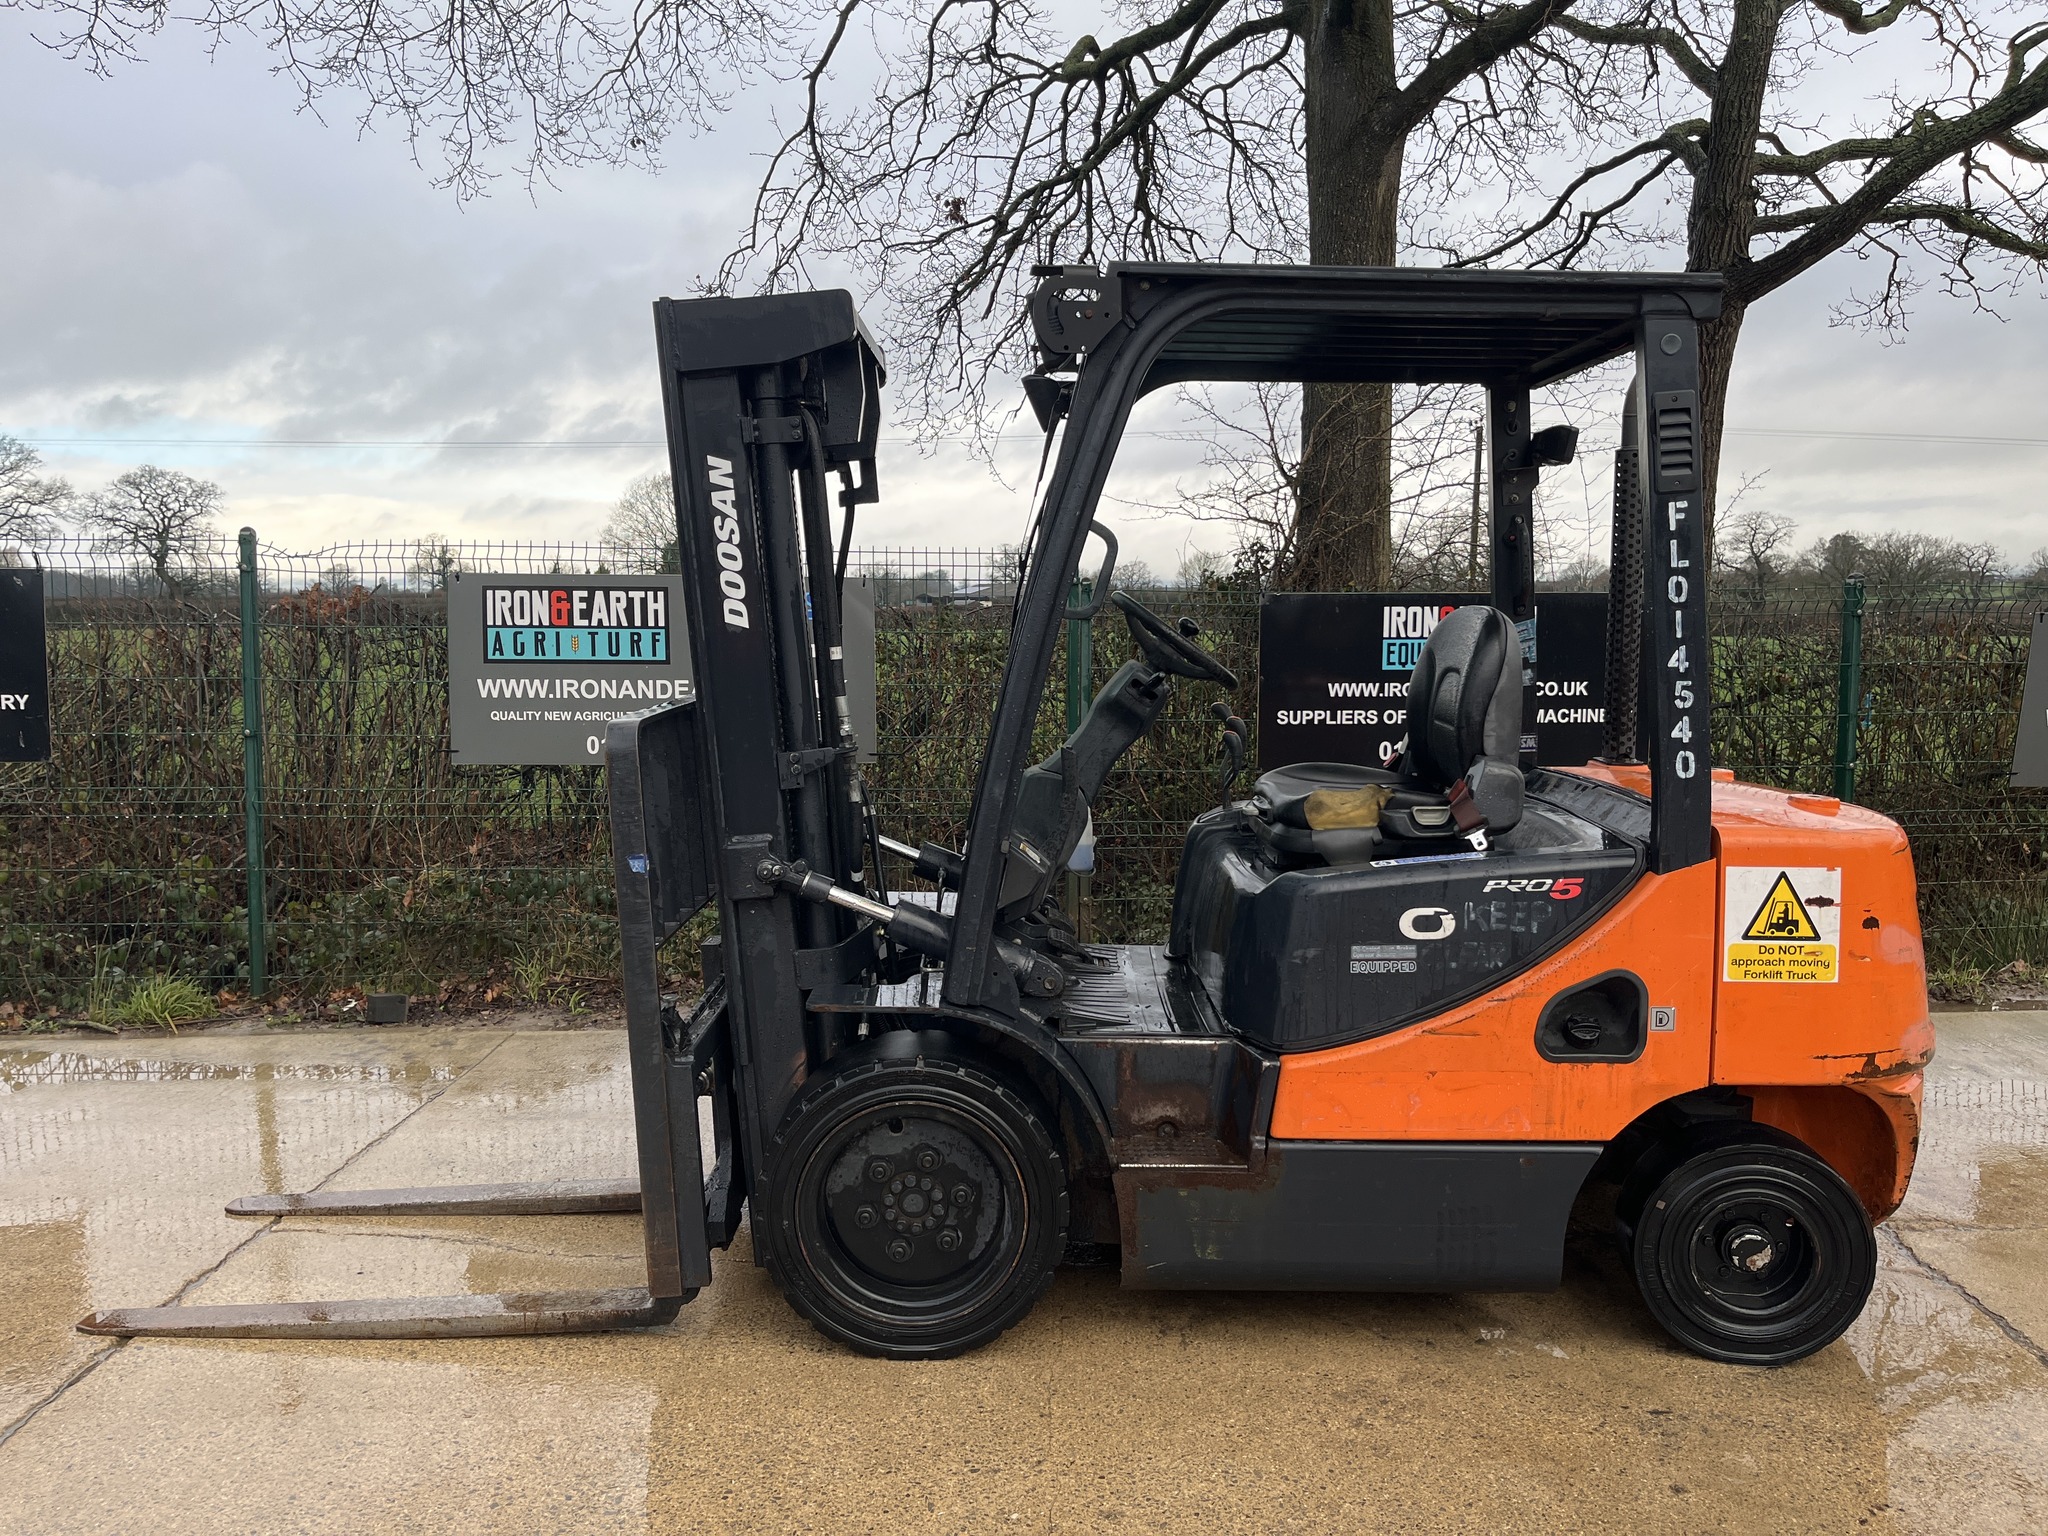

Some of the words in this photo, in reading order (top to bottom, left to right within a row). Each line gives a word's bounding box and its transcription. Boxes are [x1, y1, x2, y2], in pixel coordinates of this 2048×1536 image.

[707, 455, 749, 629] DOOSAN
[492, 631, 561, 657] AGRI
[587, 631, 661, 657] TURF
[477, 678, 695, 699] WWW.IRONANDE
[0, 694, 30, 710] RY
[490, 711, 542, 722] QUALITY
[544, 711, 572, 721] NEW
[1277, 710, 1378, 725] SUPPLIERS
[1383, 709, 1407, 725] OF
[586, 735, 606, 754] 0
[1758, 945, 1775, 955] Do
[1778, 945, 1805, 956] NOT
[1350, 961, 1417, 974] EQUIPPED
[1731, 958, 1785, 968] approach
[1789, 958, 1830, 969] moving
[1744, 970, 1783, 979] Forklift
[1786, 971, 1817, 980] Truck
